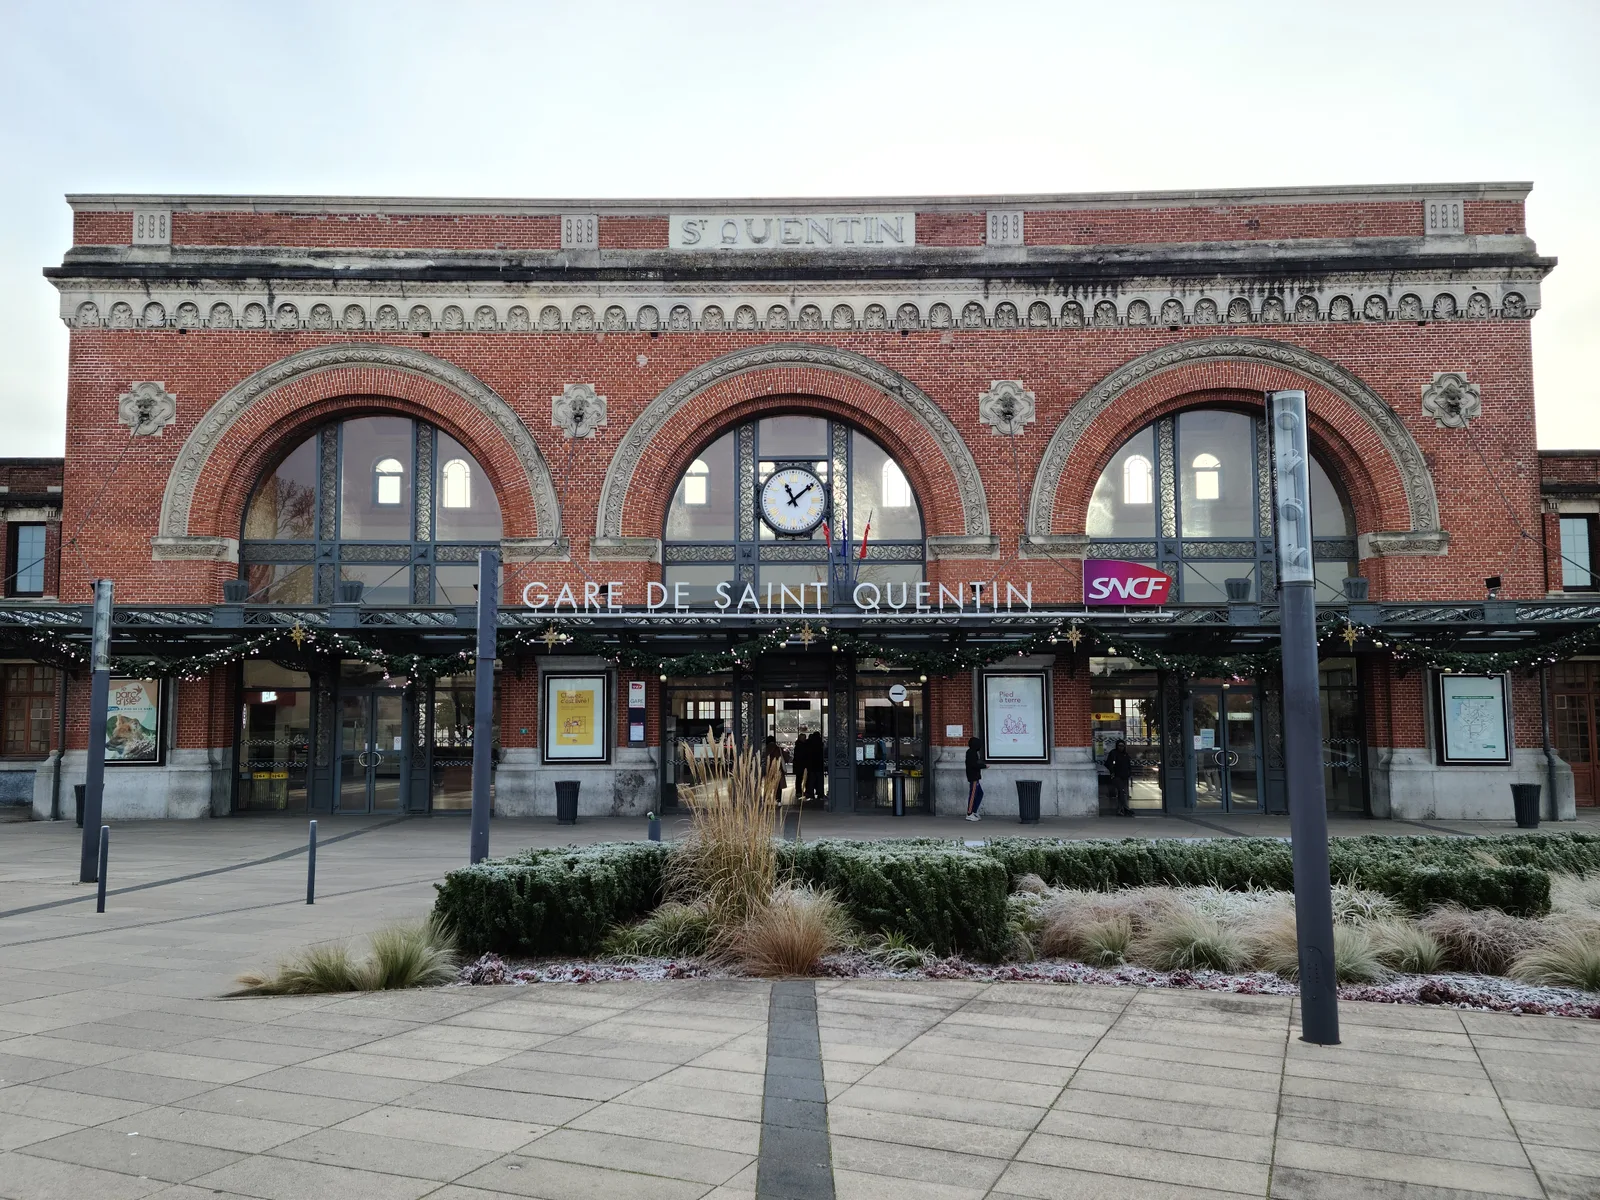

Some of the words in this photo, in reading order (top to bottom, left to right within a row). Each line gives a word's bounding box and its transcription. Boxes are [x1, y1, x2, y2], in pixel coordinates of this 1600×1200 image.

[720, 216, 905, 245] QUENTIN
[522, 581, 624, 609] GARE
[647, 581, 690, 609] DE
[714, 581, 828, 609] SAINT
[853, 581, 1032, 609] QUENTIN
[1088, 577, 1167, 600] SNCF
